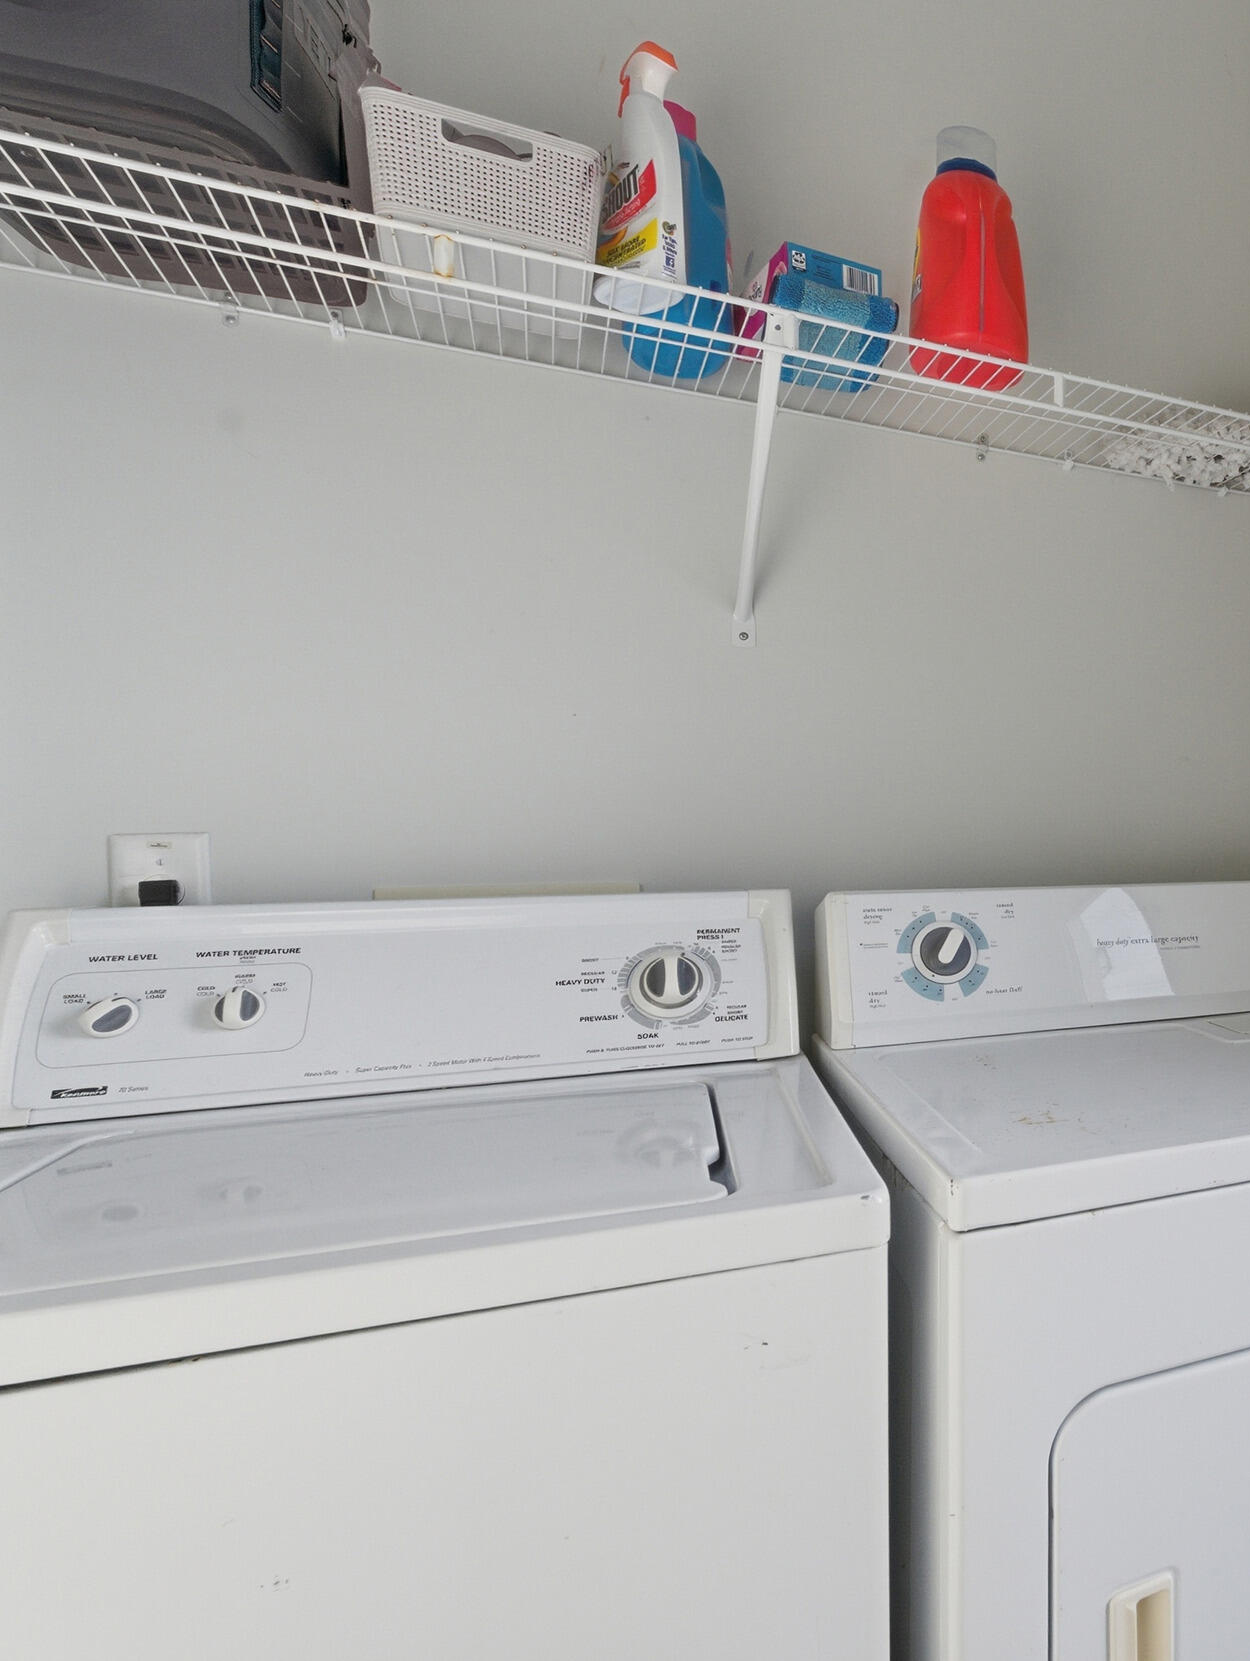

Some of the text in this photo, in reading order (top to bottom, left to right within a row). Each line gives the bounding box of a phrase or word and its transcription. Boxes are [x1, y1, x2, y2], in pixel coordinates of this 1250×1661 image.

[196, 947, 302, 958] WATER TEMPERATURE
[127, 953, 159, 961] LEVEL
[579, 1014, 618, 1022] PREWASH
[714, 1014, 748, 1022] DELICATE
